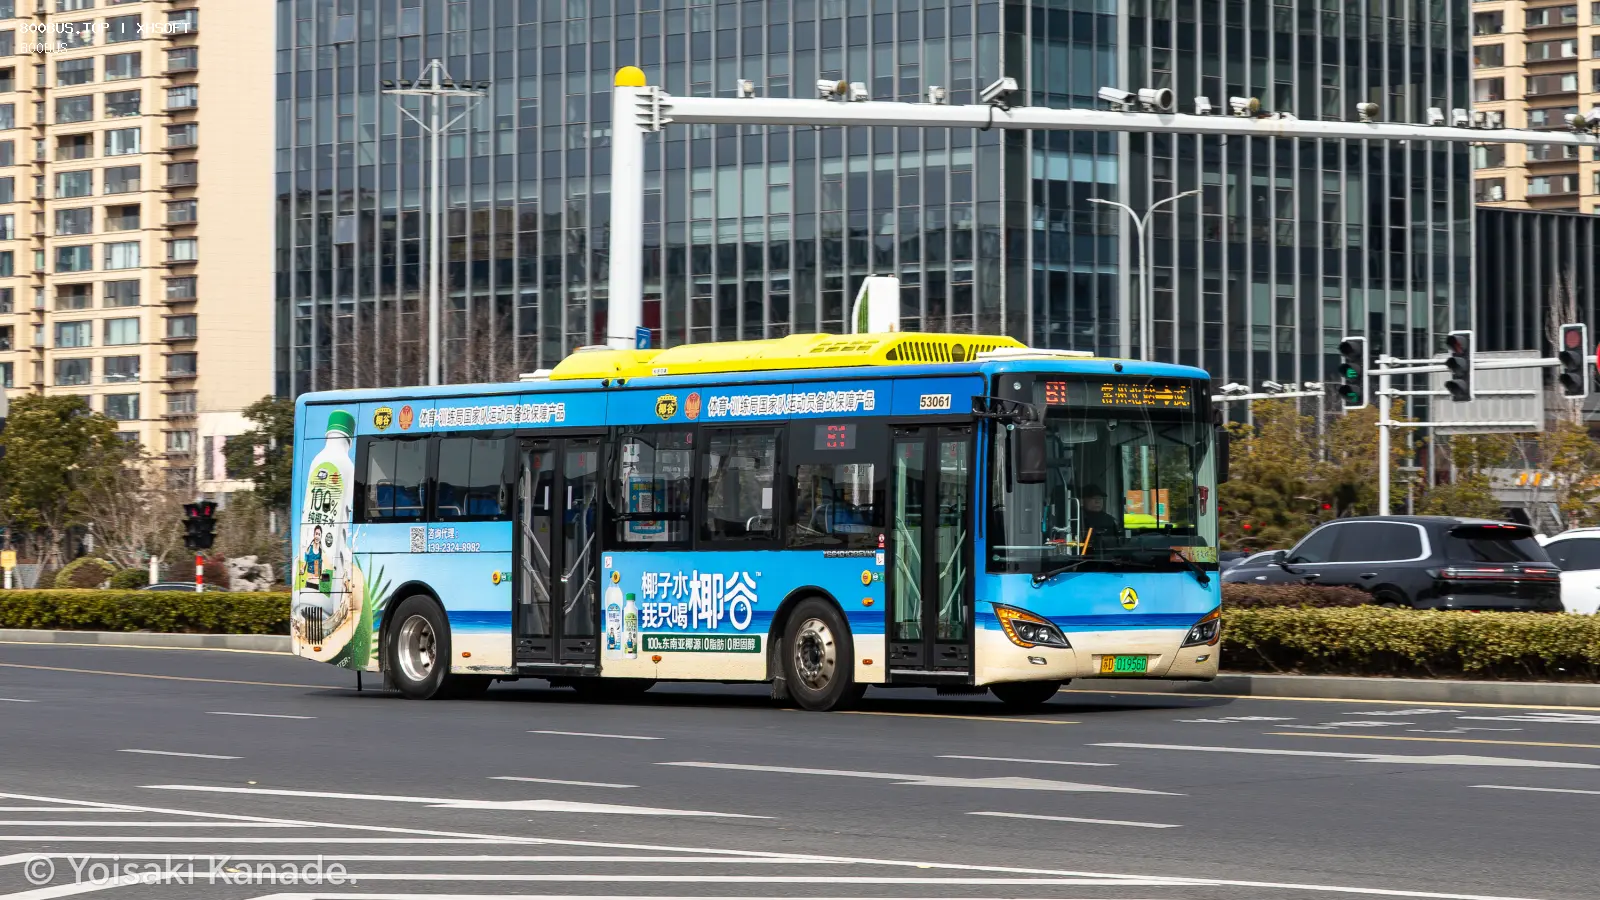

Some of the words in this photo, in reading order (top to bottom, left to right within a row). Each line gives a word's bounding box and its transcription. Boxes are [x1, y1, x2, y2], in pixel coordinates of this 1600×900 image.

[920, 395, 950, 408] 53061
[641, 571, 688, 600] 椰子水
[688, 569, 758, 631] 椰谷
[641, 602, 688, 630] 我只喝
